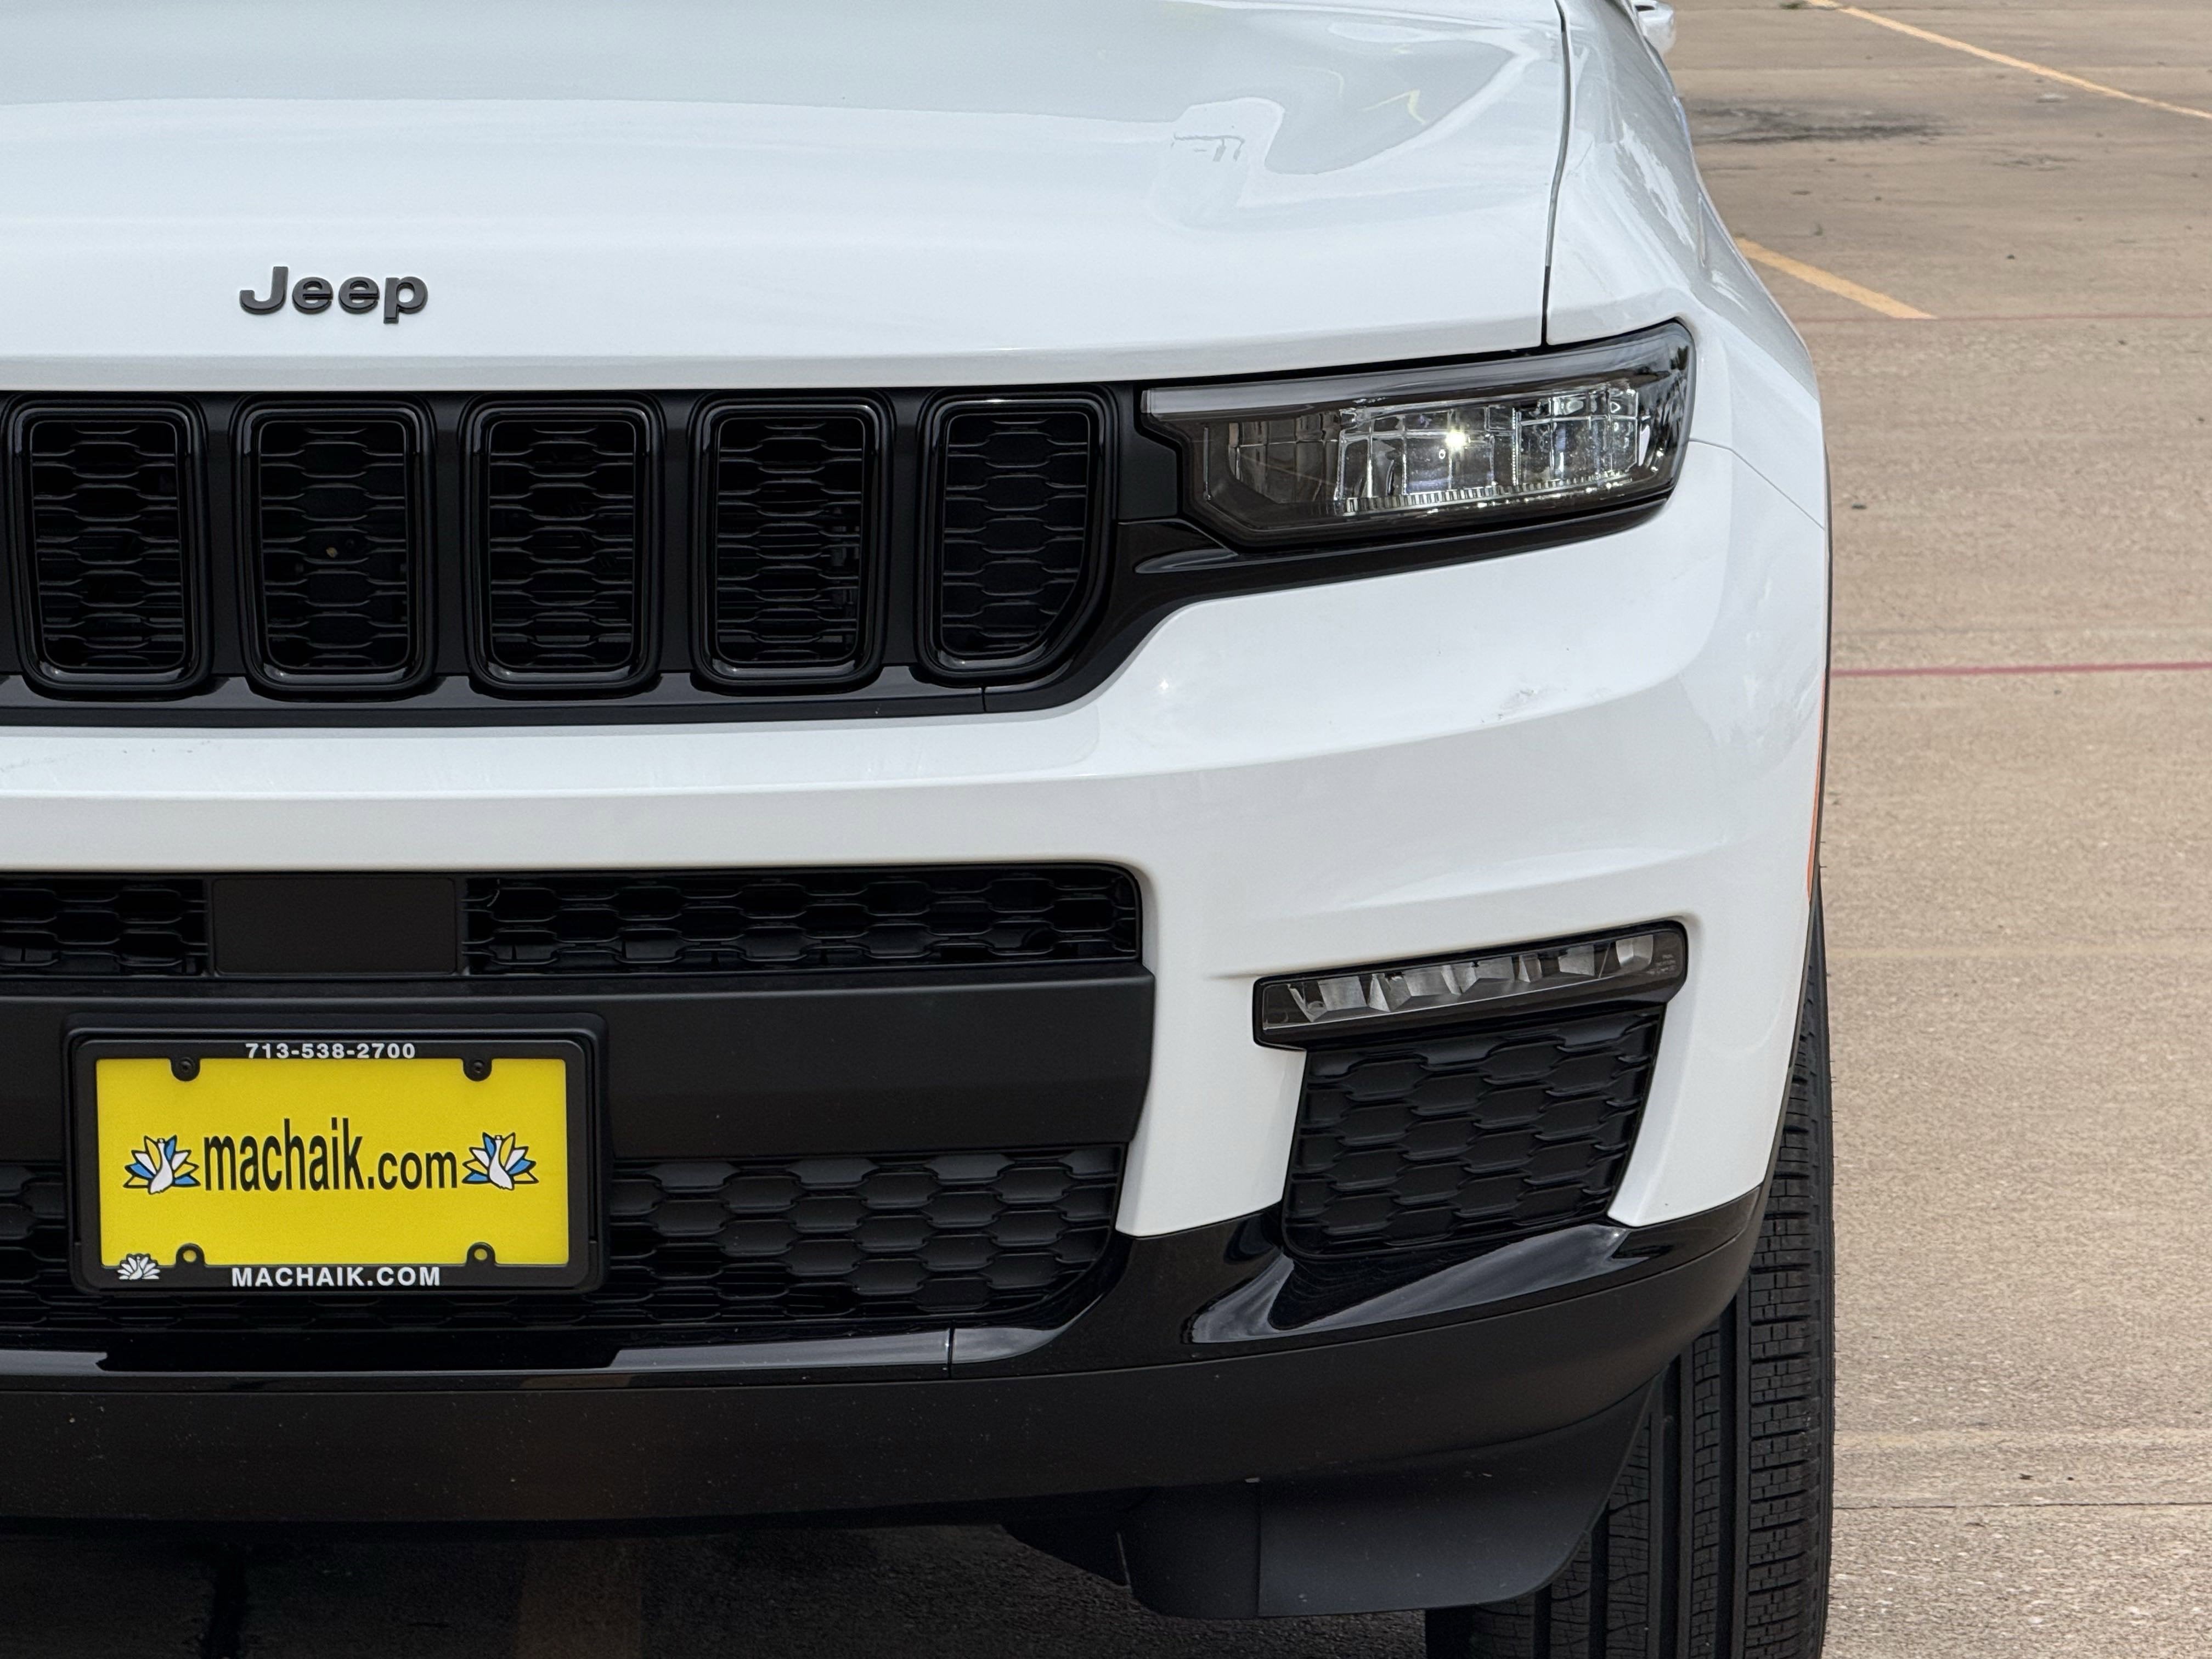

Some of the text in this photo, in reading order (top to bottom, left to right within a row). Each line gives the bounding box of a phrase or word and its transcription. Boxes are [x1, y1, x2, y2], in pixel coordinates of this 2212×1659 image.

[239, 266, 428, 324] Jeep
[245, 1043, 416, 1059] 713-538-2700
[204, 1117, 458, 1191] machaik.com
[232, 1266, 440, 1286] MACHAIK.COM
